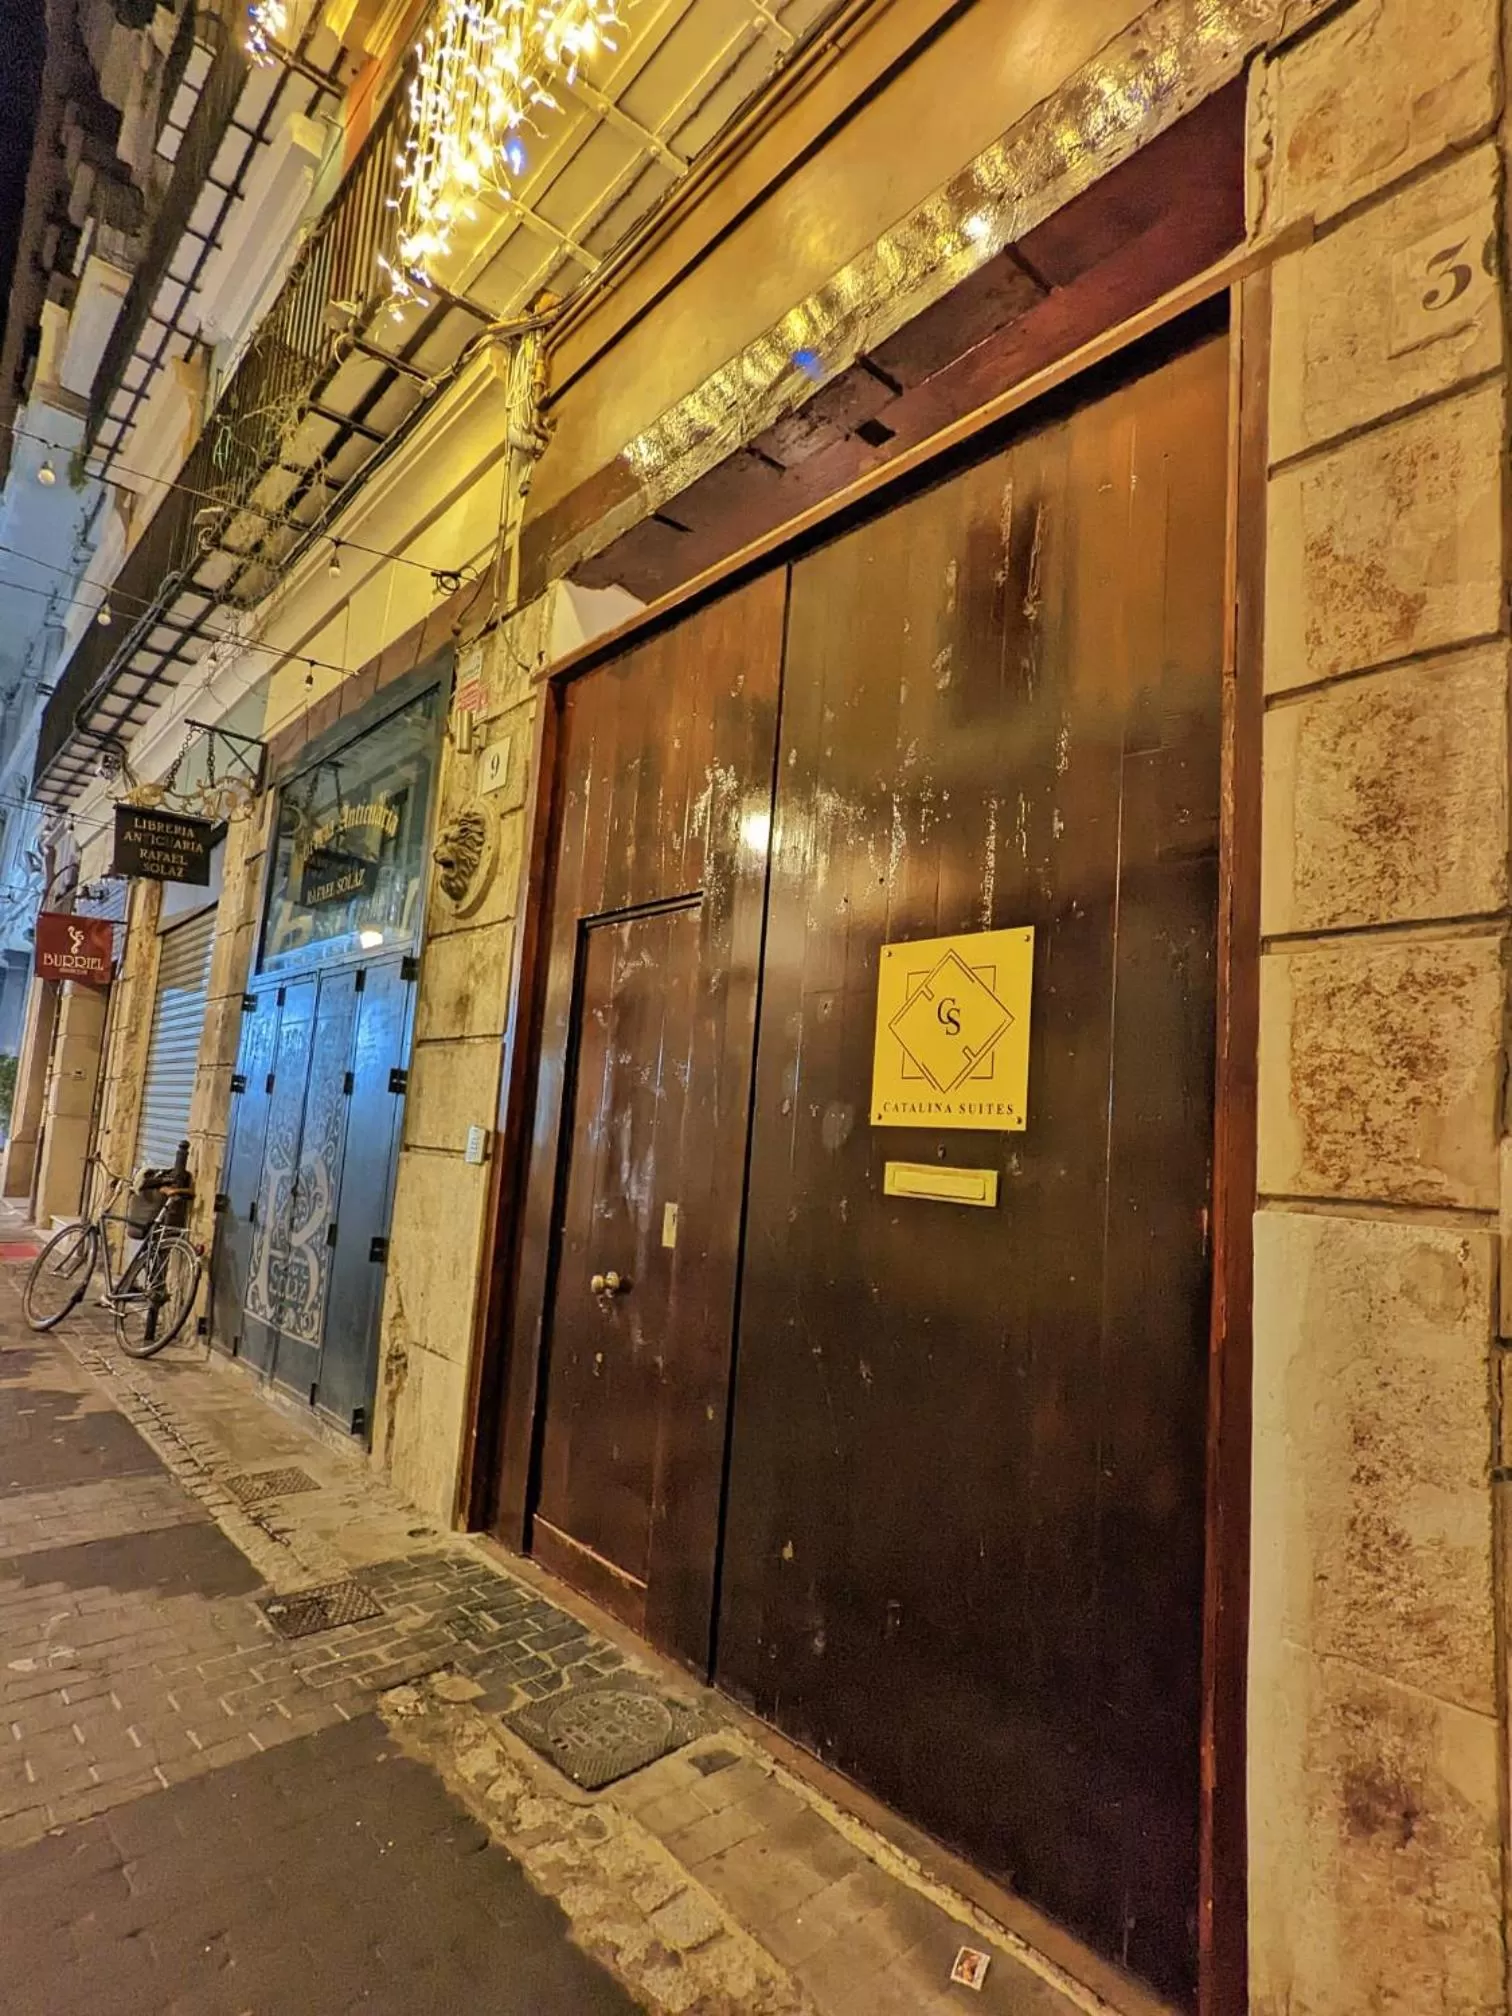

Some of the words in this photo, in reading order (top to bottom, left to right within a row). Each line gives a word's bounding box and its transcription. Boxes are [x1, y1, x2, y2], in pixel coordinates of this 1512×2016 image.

[1421, 235, 1473, 311] 3
[490, 755, 501, 779] 9
[139, 848, 188, 866] RAFAEL
[143, 863, 185, 878] SOLAZ
[336, 868, 367, 895] SOLAZ
[43, 952, 104, 970] BURRIEL
[882, 1101, 953, 1115] CATALINA
[958, 1102, 1015, 1116] SUITES
